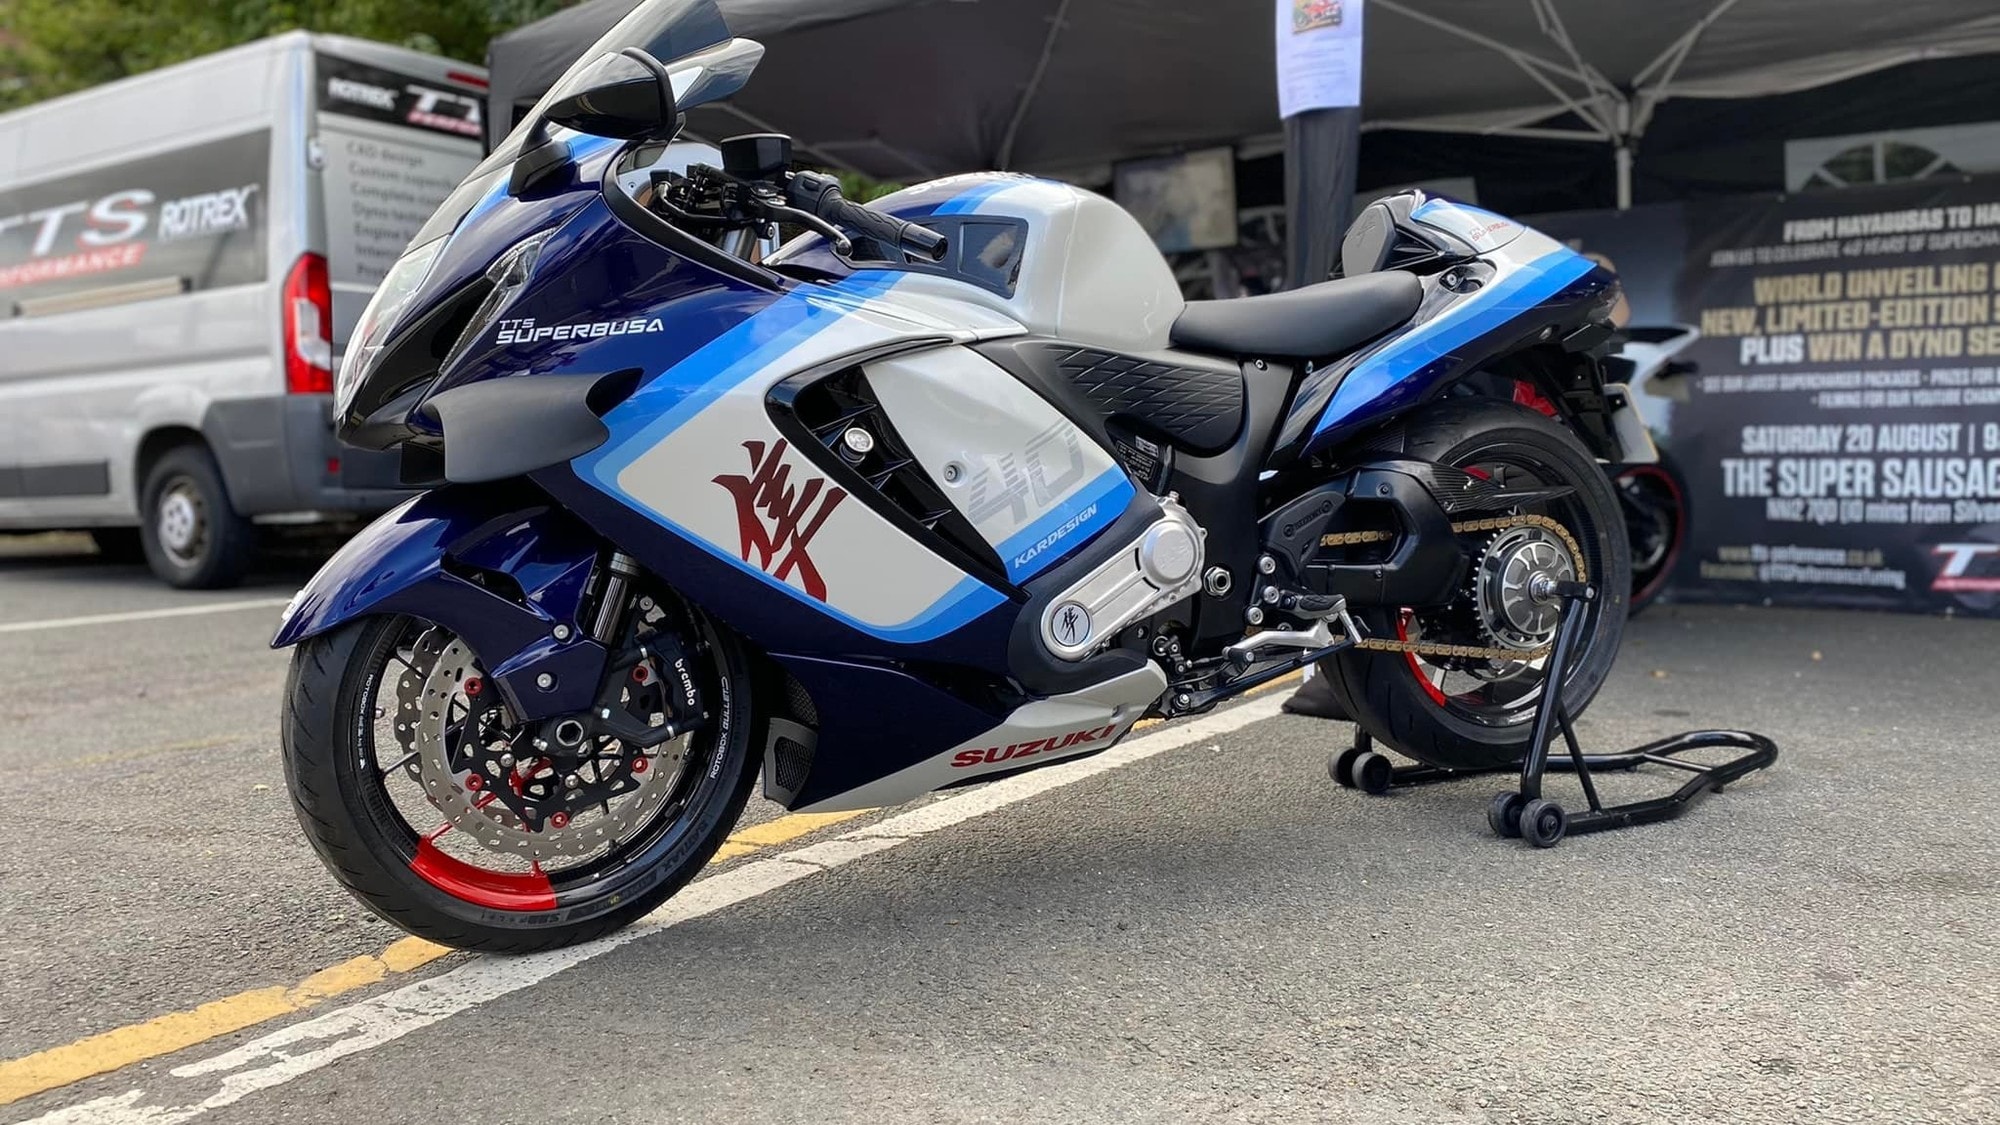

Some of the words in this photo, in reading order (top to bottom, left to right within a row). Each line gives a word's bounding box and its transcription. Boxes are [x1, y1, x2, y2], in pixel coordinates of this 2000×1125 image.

[158, 183, 259, 242] ROTREX
[1783, 218, 1835, 242] FROM
[1836, 208, 1943, 238] HAYABUSAS
[1945, 206, 1972, 229] TO
[1864, 235, 1905, 255] YEARS
[1907, 233, 1926, 252] OF
[1754, 273, 1842, 306] WORLD
[1847, 263, 1987, 298] UNVEILING
[496, 318, 664, 345] SUPERBUSA
[499, 318, 535, 330] TTS
[1701, 308, 1761, 337] NEW,
[1765, 293, 1988, 334] LIMITED-EDITION
[1740, 335, 1804, 365] PLUS
[1808, 333, 1862, 362] WIN
[1867, 332, 1886, 359] A
[1890, 330, 1963, 359] DYNO
[1742, 425, 1842, 454] SATURDAY
[1845, 425, 1873, 451] 20
[1878, 423, 1960, 451] AUGUST
[1721, 459, 1774, 497] THE
[1777, 458, 1875, 497] SUPER
[1865, 500, 1908, 522] mins
[1910, 500, 1951, 523] from
[1014, 503, 1098, 569] KARDESIGN
[675, 658, 697, 706] brembo
[950, 704, 1117, 767] SUZUKI
[709, 732, 728, 779] ROTOBOX
